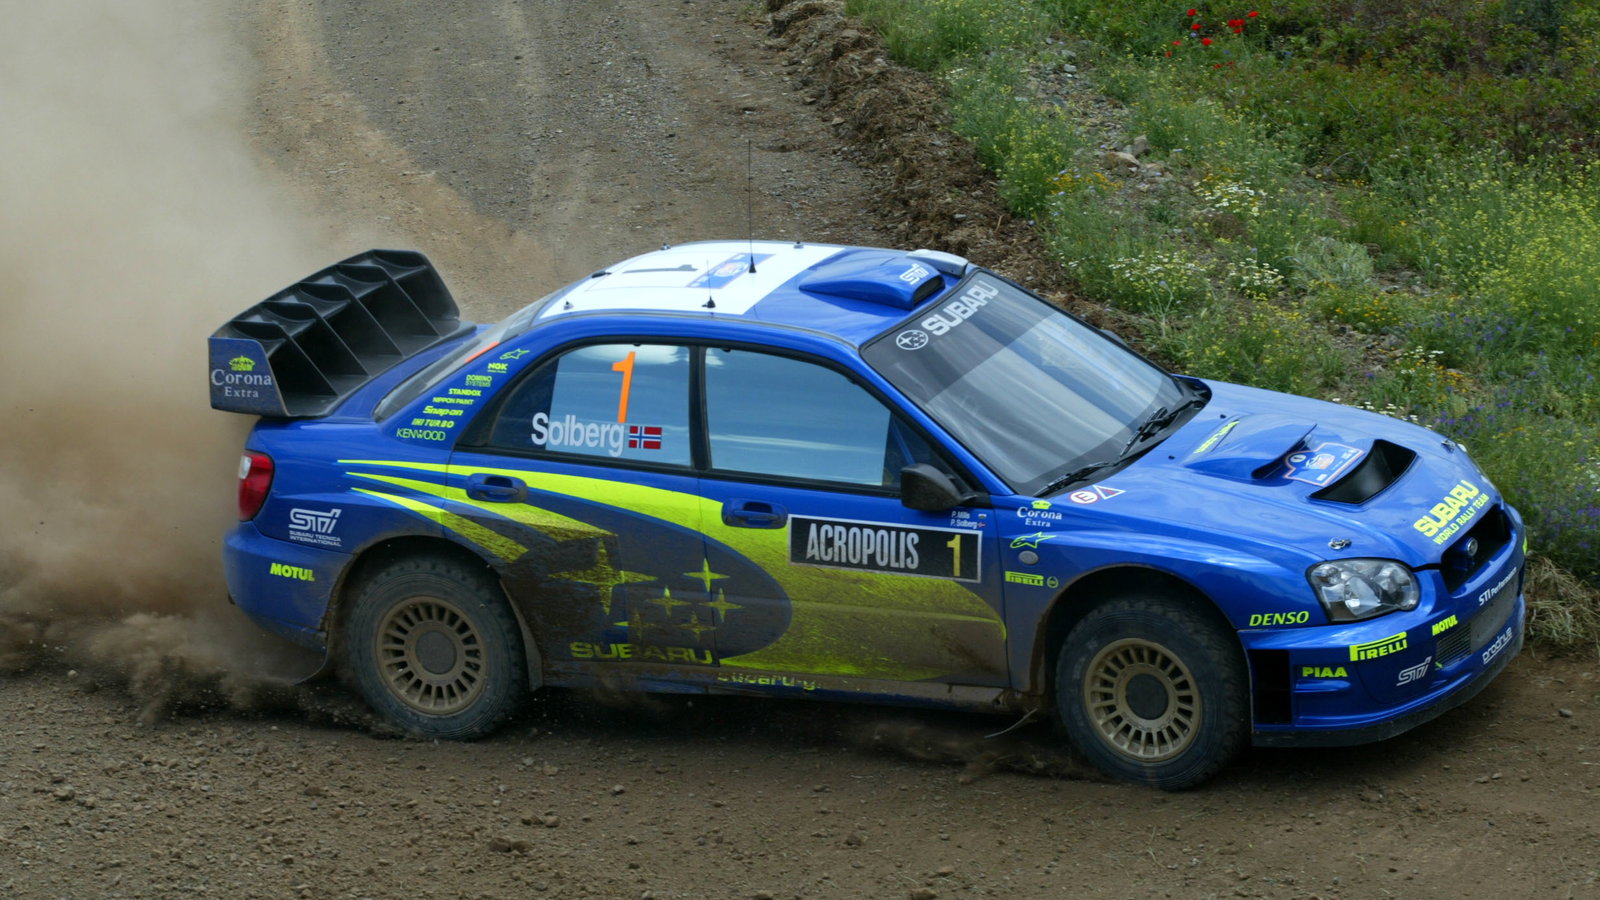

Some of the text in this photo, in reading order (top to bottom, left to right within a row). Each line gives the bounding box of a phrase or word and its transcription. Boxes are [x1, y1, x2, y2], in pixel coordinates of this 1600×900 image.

[921, 280, 999, 336] SUBARU
[212, 369, 272, 386] Corona
[224, 387, 259, 398] Extra
[449, 388, 482, 397] STANDOX
[612, 351, 636, 424] 1
[423, 405, 464, 416] Snap-on
[396, 428, 446, 441] KENWOOD
[531, 412, 624, 457] Solberg
[1016, 506, 1062, 520] Corona
[1413, 479, 1479, 537] SUBARU
[1025, 518, 1051, 527] Extra
[1432, 493, 1490, 545] WORLD RALLY TEAM
[289, 530, 314, 538] SUBARU
[289, 536, 342, 547] INTERNATIONAL
[806, 523, 961, 576] ACROPOLIS 1
[270, 563, 315, 581] MOTUL
[1249, 611, 1310, 627] DENSO
[1432, 614, 1458, 636] MOTUL
[1350, 631, 1408, 661] PIRELLI
[1302, 666, 1348, 678] PIAA
